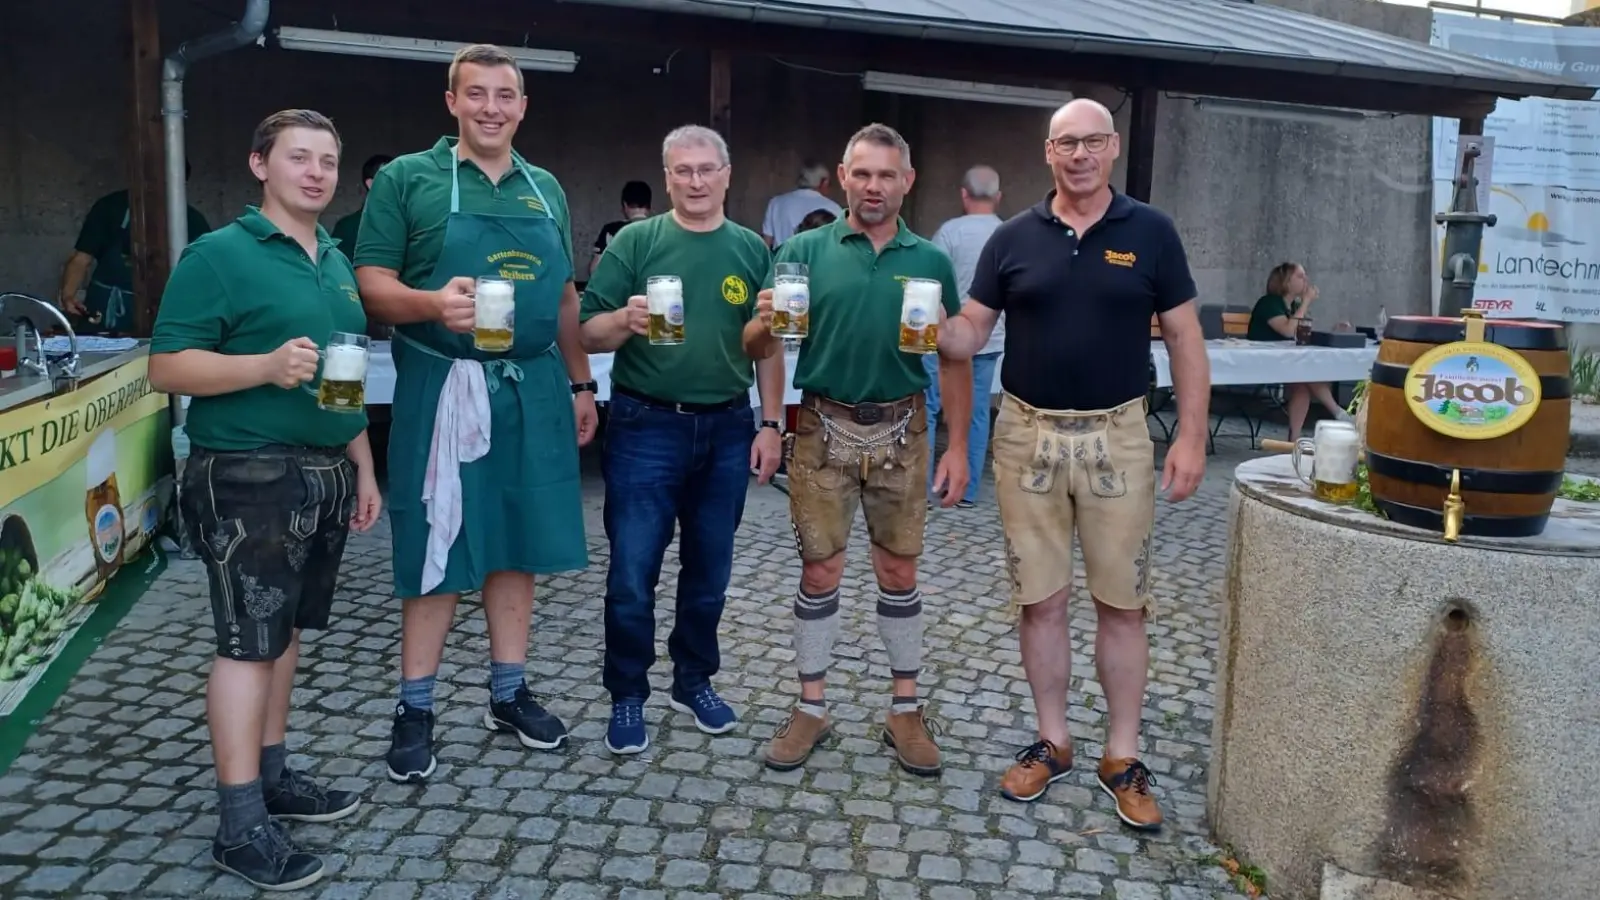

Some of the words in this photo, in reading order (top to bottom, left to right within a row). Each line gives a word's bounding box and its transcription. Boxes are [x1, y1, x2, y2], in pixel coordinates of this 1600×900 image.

[1104, 250, 1136, 262] Jacob
[1473, 300, 1513, 310] STEYR
[1412, 373, 1535, 406] Jacob
[41, 409, 80, 455] DIE
[84, 375, 156, 433] OBERPFAL
